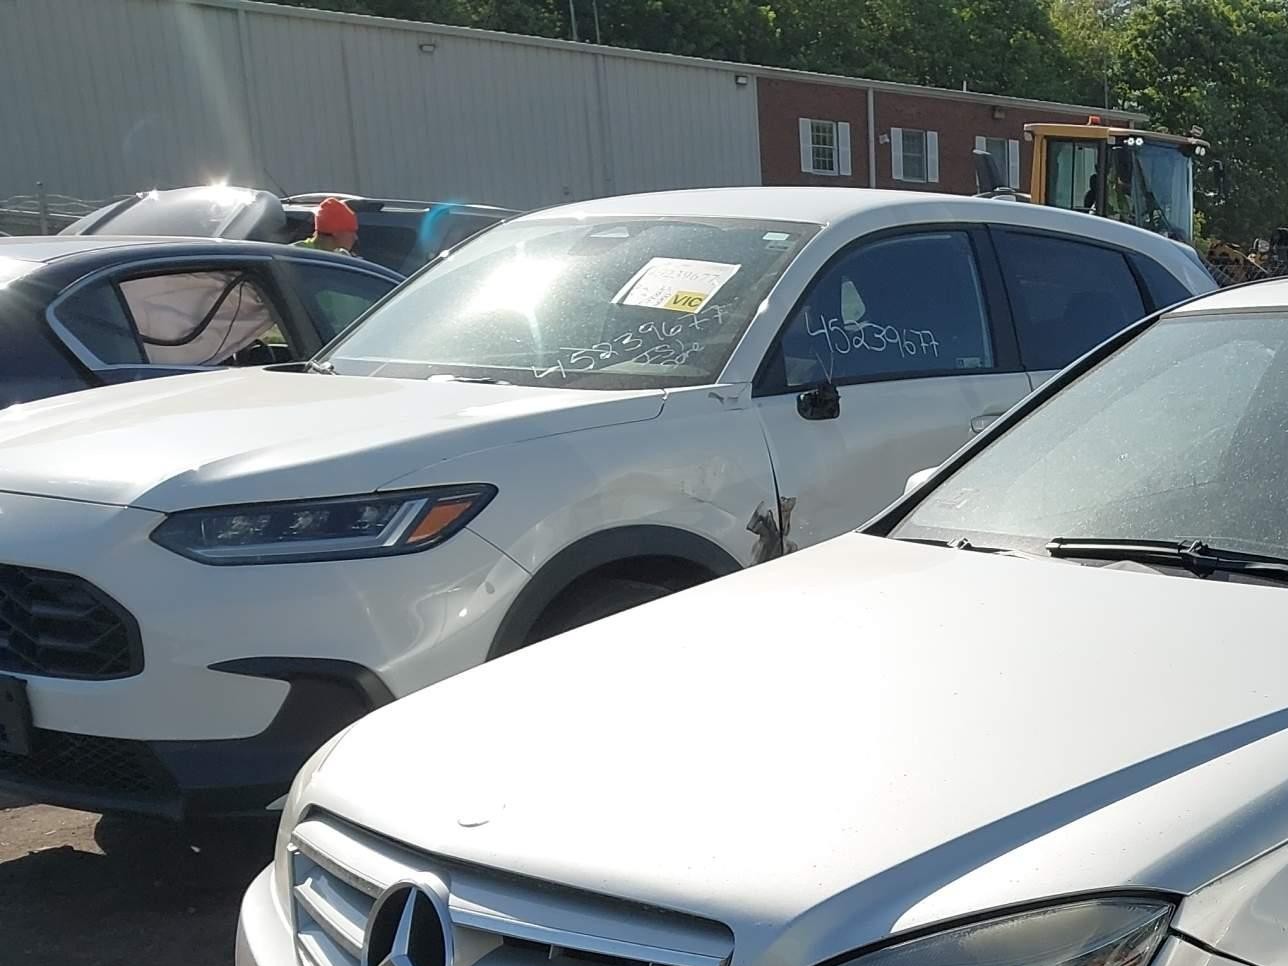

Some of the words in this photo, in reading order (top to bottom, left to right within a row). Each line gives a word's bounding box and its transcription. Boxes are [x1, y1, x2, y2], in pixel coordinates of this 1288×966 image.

[673, 294, 702, 308] VIC
[531, 303, 731, 378] 45239677
[804, 311, 939, 358] 45239677
